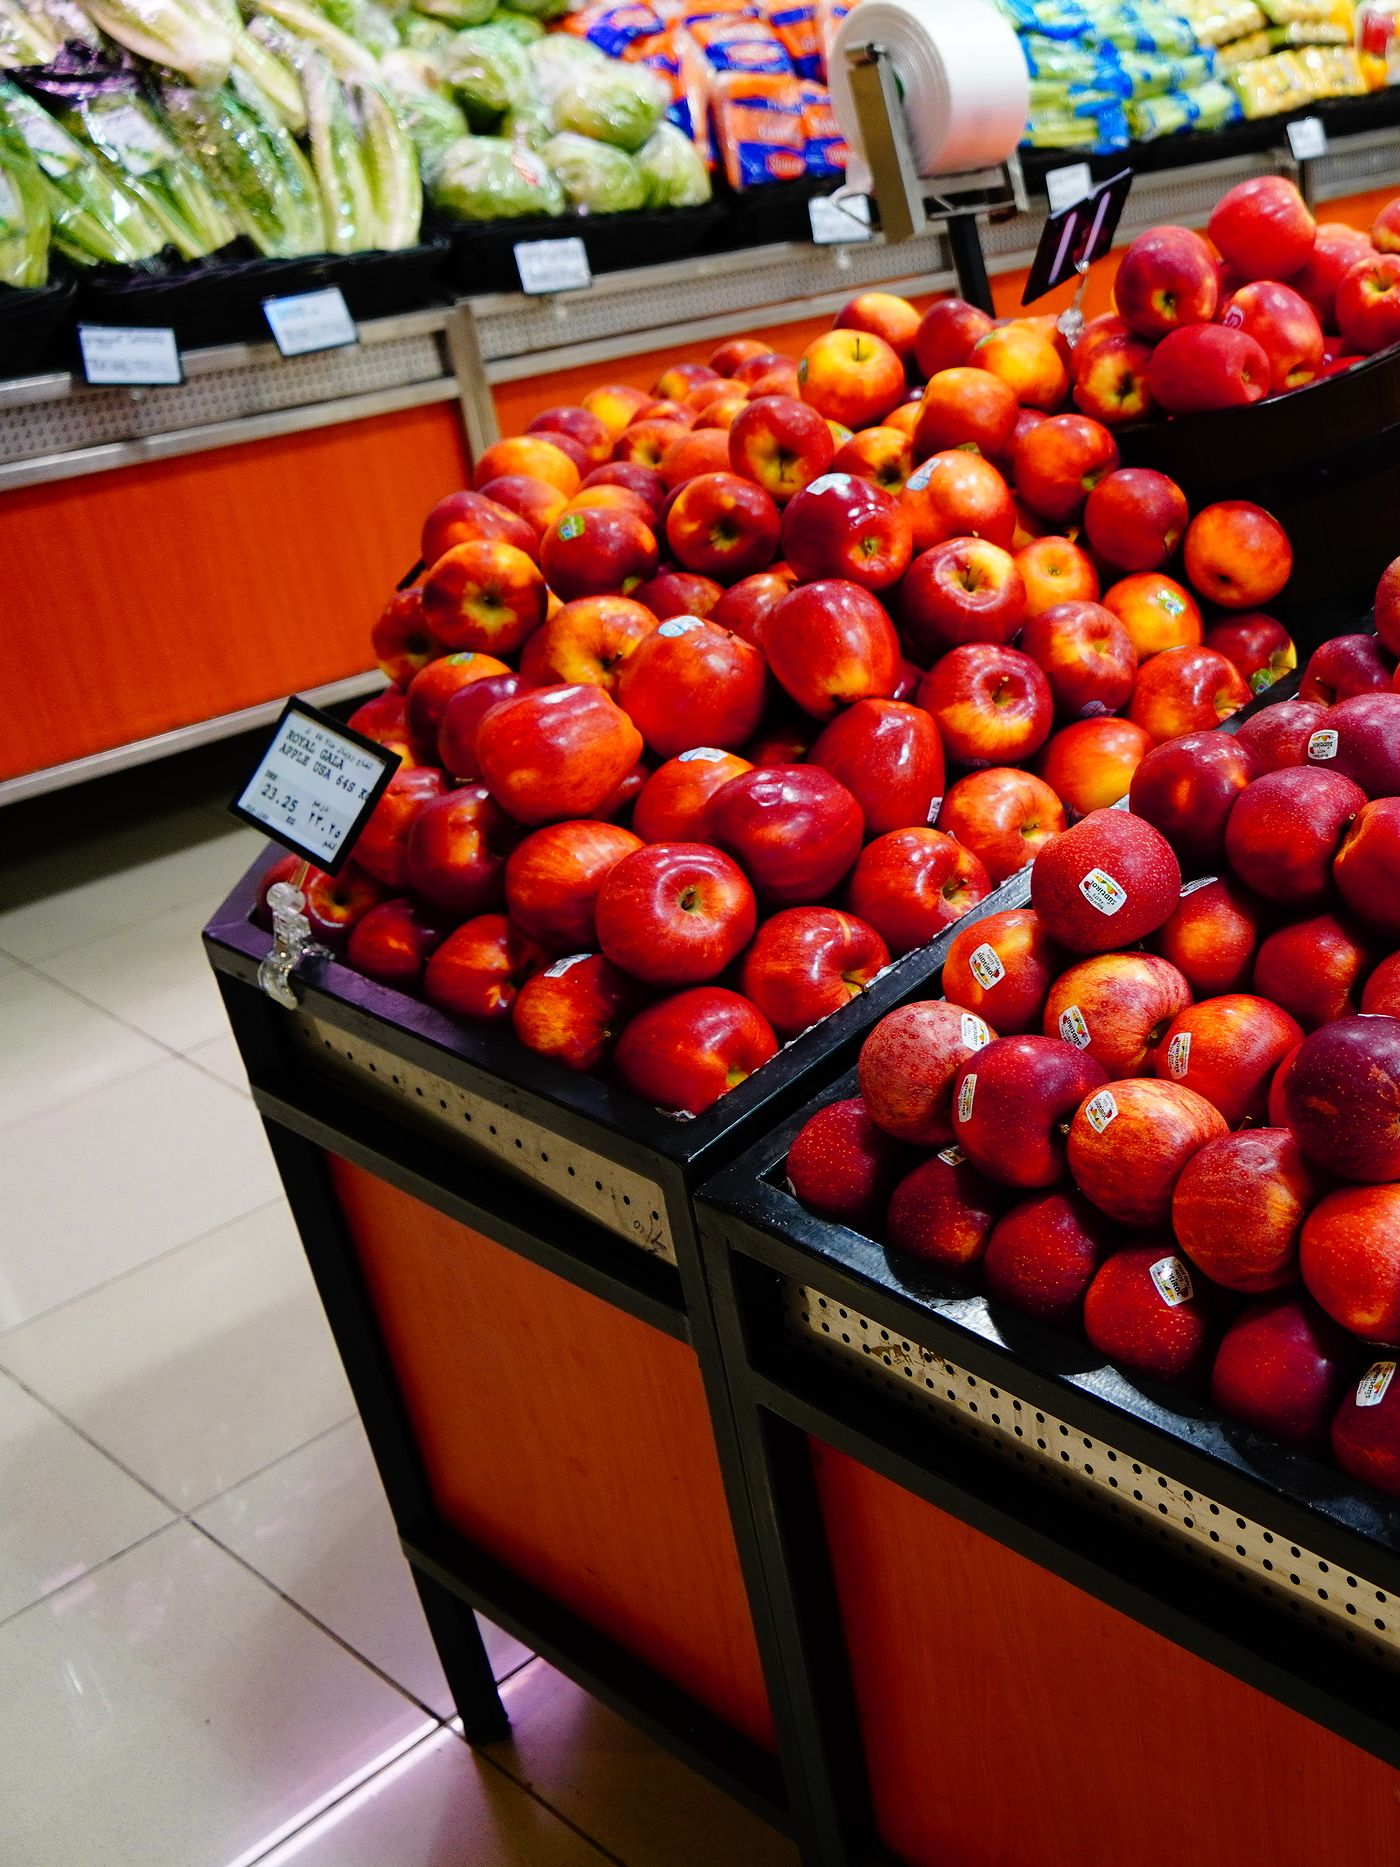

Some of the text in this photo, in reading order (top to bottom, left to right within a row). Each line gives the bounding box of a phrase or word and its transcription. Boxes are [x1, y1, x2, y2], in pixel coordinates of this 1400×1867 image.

[278, 742, 311, 767] APPLE
[312, 762, 334, 780] USA
[285, 729, 318, 754] ROYAL
[318, 748, 347, 771] GALA
[259, 783, 300, 814] 23.25
